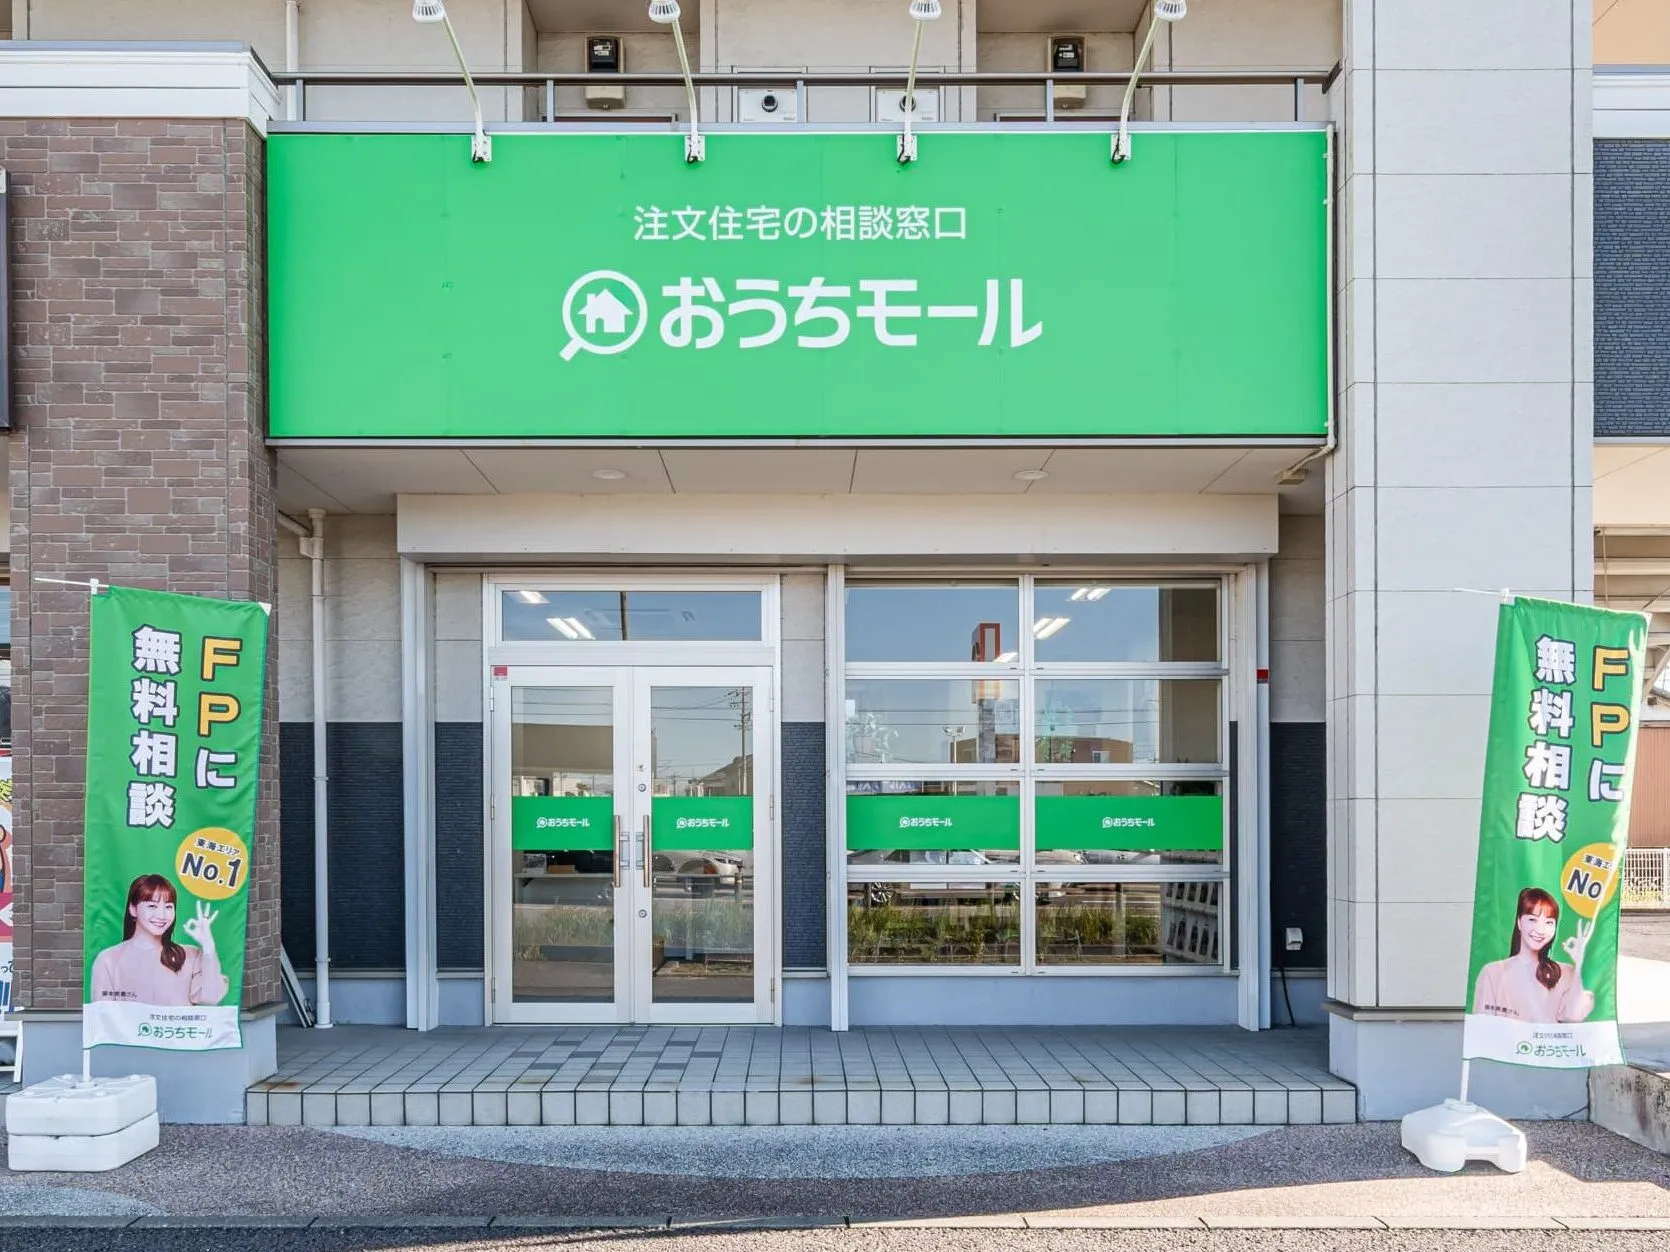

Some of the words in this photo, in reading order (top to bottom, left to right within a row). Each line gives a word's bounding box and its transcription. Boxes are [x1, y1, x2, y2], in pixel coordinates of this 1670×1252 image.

[633, 205, 967, 242] 注文住宅の相談窓口
[659, 276, 1043, 349] おうちモール
[127, 624, 182, 829] 無料相談
[195, 636, 243, 789] FPに
[1588, 645, 1631, 802] FPに
[1516, 634, 1576, 843] 無料相談
[547, 817, 591, 828] おうちモール
[688, 817, 730, 828] おうちモール
[910, 817, 953, 828] おうちモール
[1113, 817, 1155, 828] おうちモール
[181, 852, 242, 888] No.1
[153, 1025, 213, 1040] おうちモール
